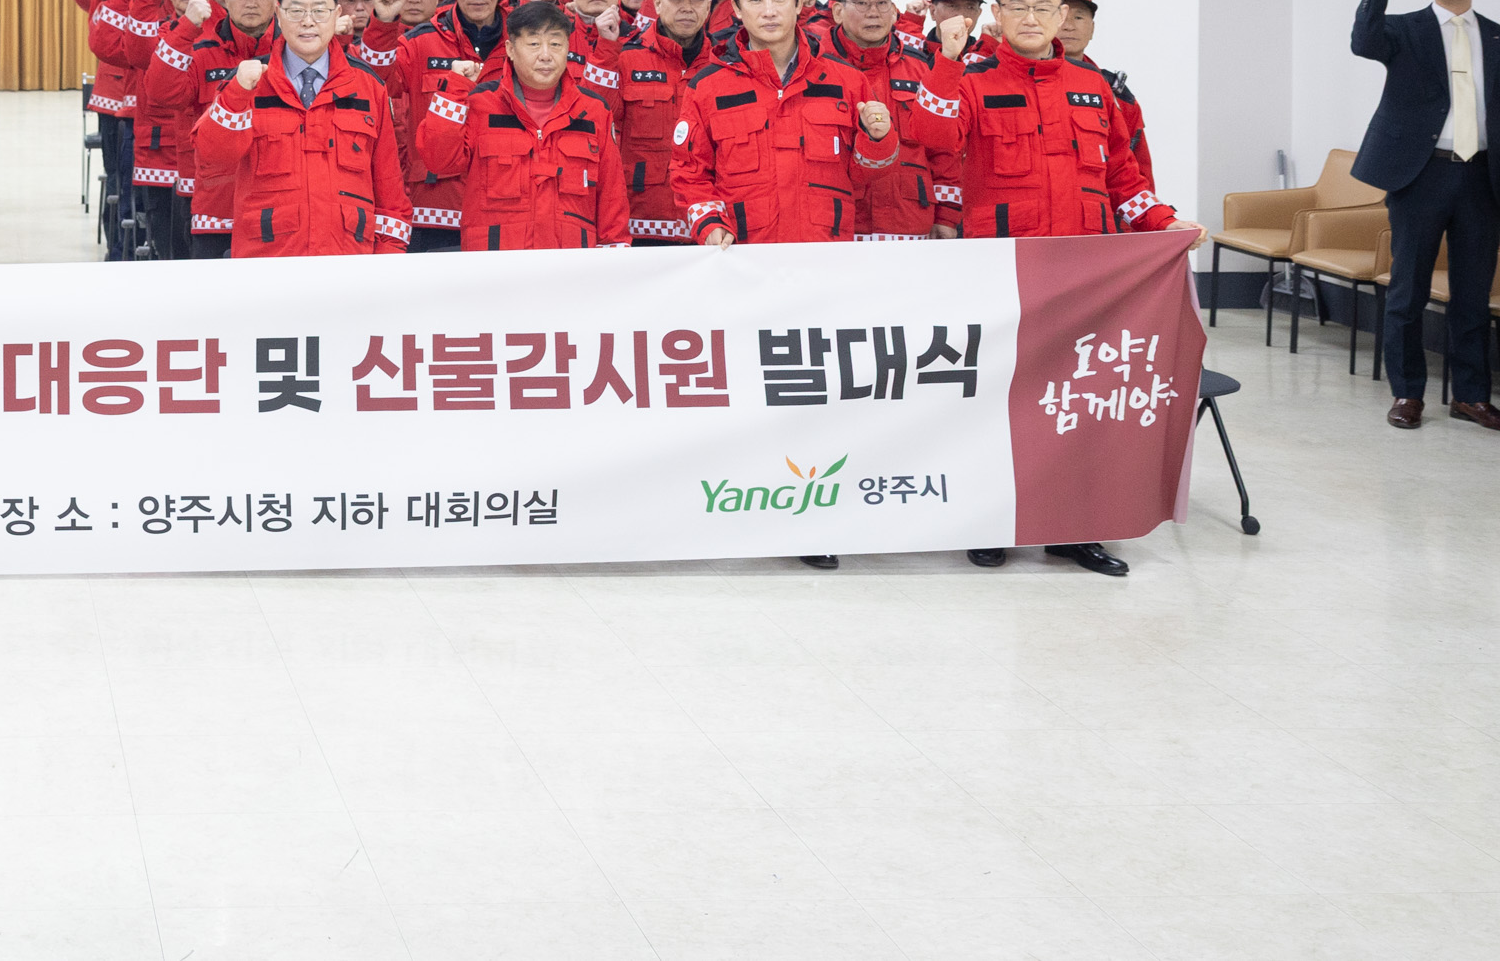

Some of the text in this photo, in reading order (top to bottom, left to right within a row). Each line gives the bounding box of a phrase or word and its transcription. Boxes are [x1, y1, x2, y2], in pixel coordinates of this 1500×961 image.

[256, 336, 322, 412] 및
[352, 330, 730, 411] 산불감시원
[759, 324, 981, 406] 발대식
[1072, 329, 1160, 382] 도약!
[1038, 374, 1179, 435] 함께양
[0, 496, 40, 536] 장
[54, 496, 93, 531] 소
[138, 493, 293, 535] 양주시청
[311, 492, 389, 531] 지하
[407, 488, 558, 529] 대회의실
[858, 473, 948, 506] 양주시
